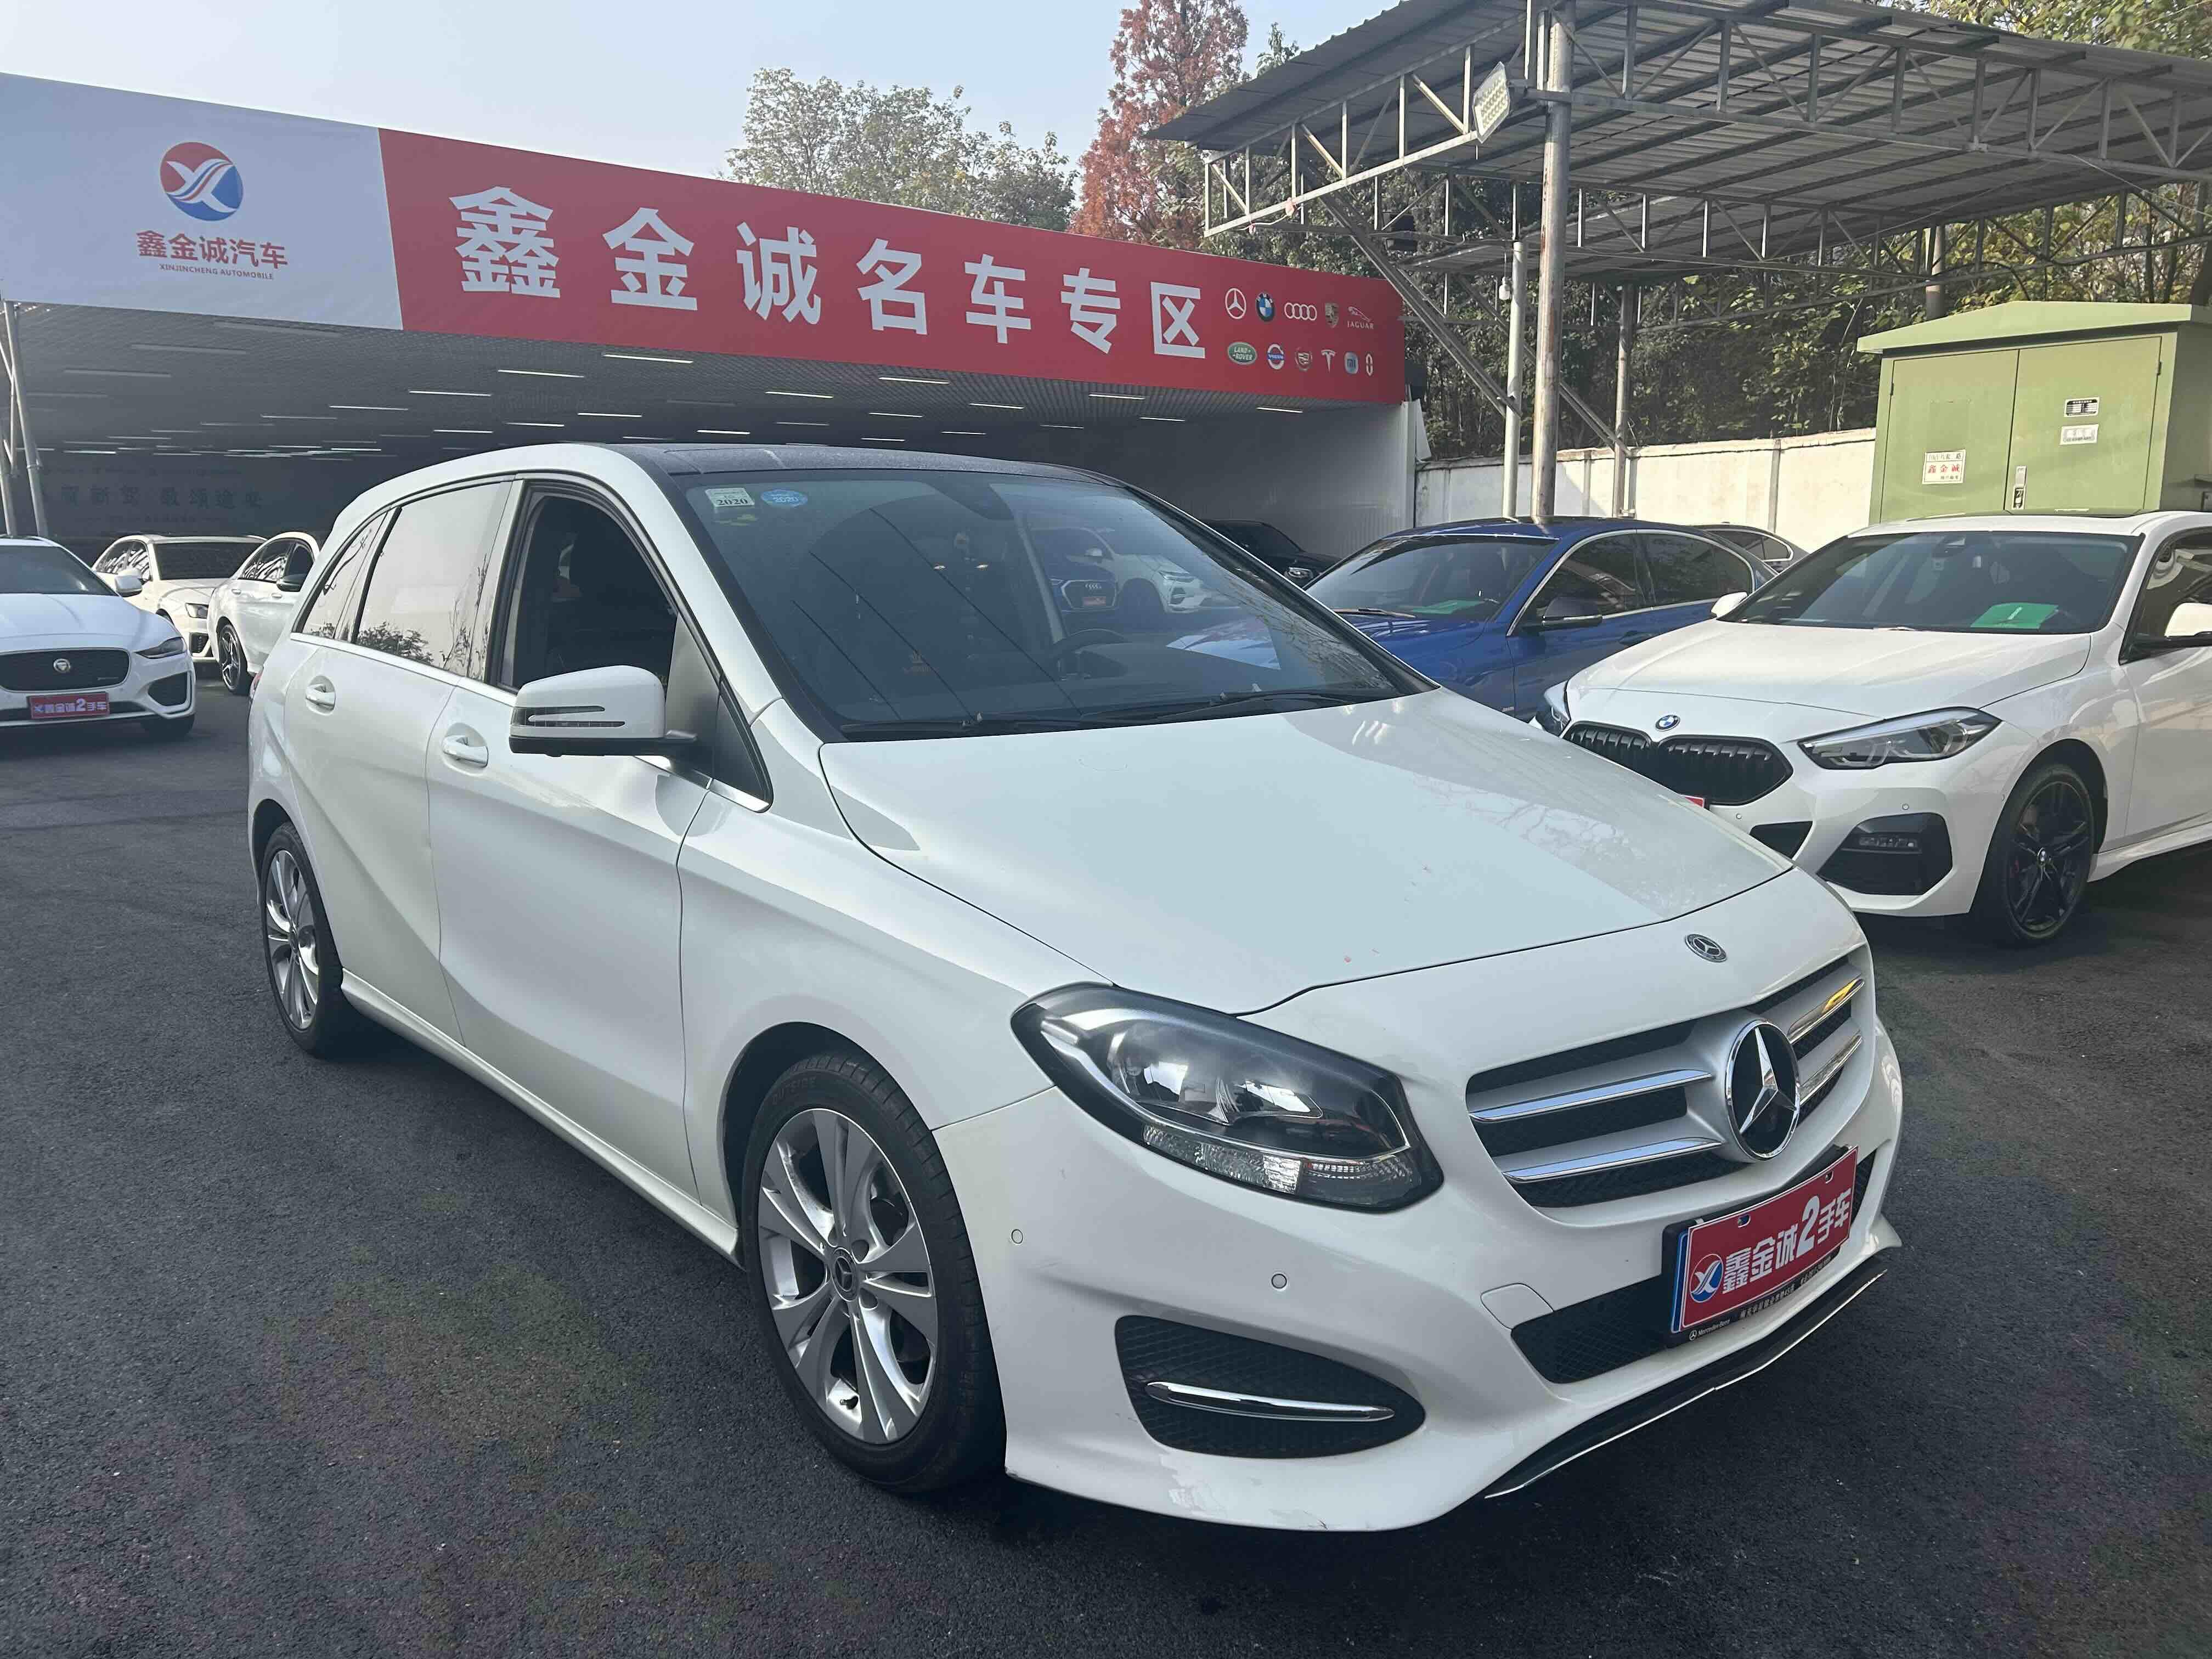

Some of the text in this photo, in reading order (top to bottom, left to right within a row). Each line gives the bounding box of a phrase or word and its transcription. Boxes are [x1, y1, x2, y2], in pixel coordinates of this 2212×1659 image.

[136, 229, 289, 270] 鑫金诚汽车
[159, 263, 274, 280] XINJINCHENG AUTOMOBILE
[448, 185, 1206, 359] 鑫金诚名车专区
[1347, 320, 1374, 330] JAGUAR
[716, 498, 748, 506] 2020
[1722, 1188, 1852, 1294] 鑫金诚2手车
